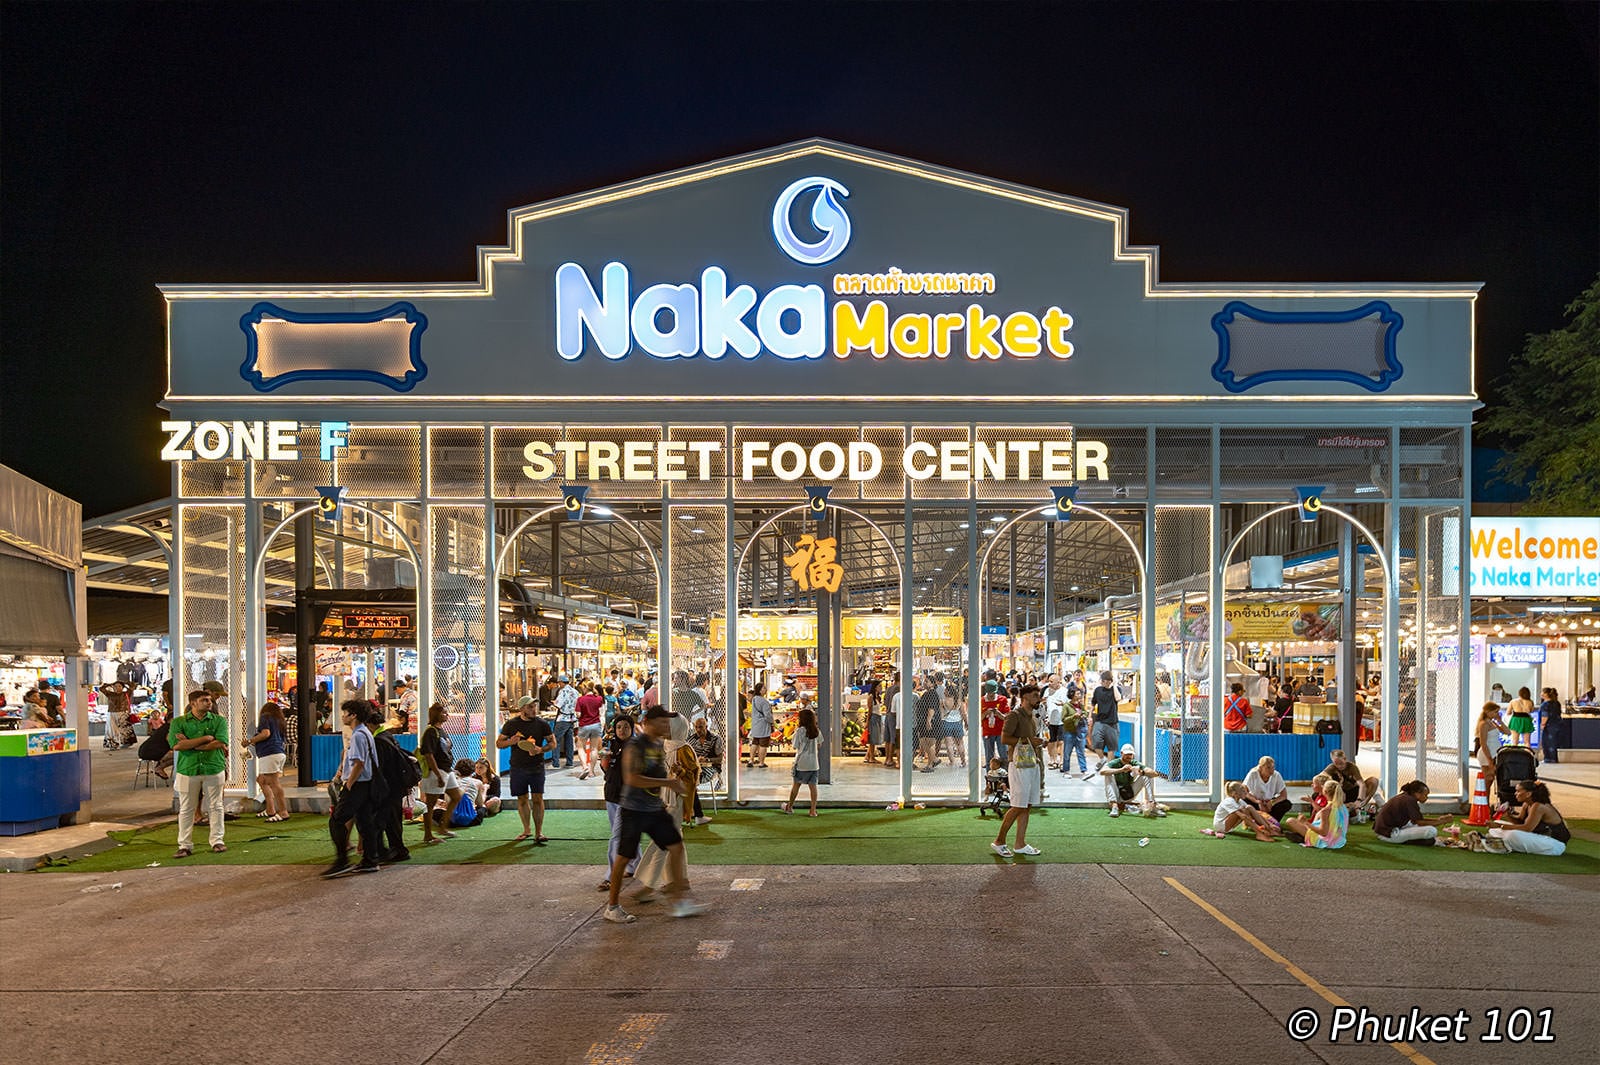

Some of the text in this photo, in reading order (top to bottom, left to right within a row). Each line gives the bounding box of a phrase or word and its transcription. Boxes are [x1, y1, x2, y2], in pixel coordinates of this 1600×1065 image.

[555, 261, 1075, 361] Naka Market
[160, 421, 349, 462] ZONE F
[522, 440, 1109, 481] STREET FOOD CENTER
[1470, 527, 1598, 560] Welcome
[783, 534, 845, 593] 福
[1482, 565, 1531, 587] Naka
[1537, 565, 1600, 587] Marke
[505, 622, 549, 637] SIAM KEBAB
[717, 624, 817, 641] FESH FRUI
